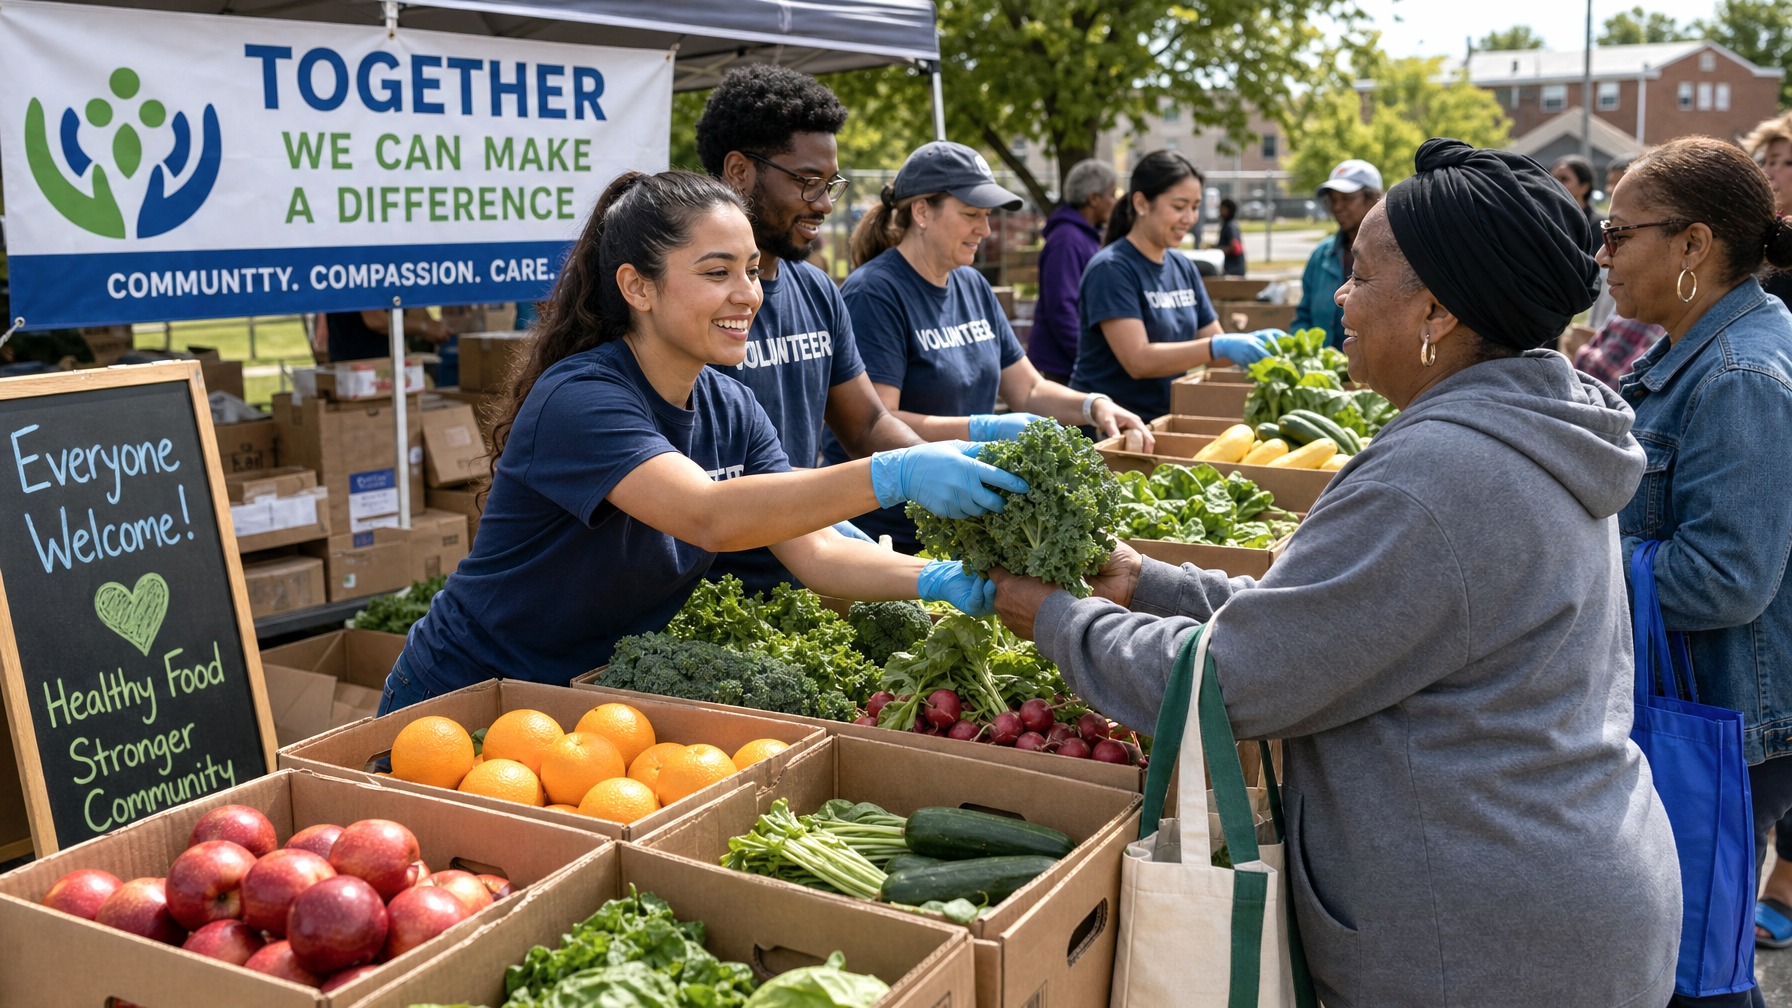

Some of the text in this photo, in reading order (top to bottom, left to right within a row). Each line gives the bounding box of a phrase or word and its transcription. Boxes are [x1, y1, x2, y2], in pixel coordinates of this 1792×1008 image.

[245, 44, 607, 121] TOGETHER
[282, 131, 592, 172] WE CAN MAKE
[286, 187, 575, 224] A DIFFERENCE
[107, 258, 555, 299] COMMUNTTY. COMPASSION. CARE.
[735, 330, 833, 371] OLUNTEER
[10, 424, 180, 505] Everyone
[24, 484, 195, 574] Welcome!
[43, 641, 225, 725] Healthy Food
[69, 722, 196, 785] Stronger
[84, 754, 236, 833] Community
